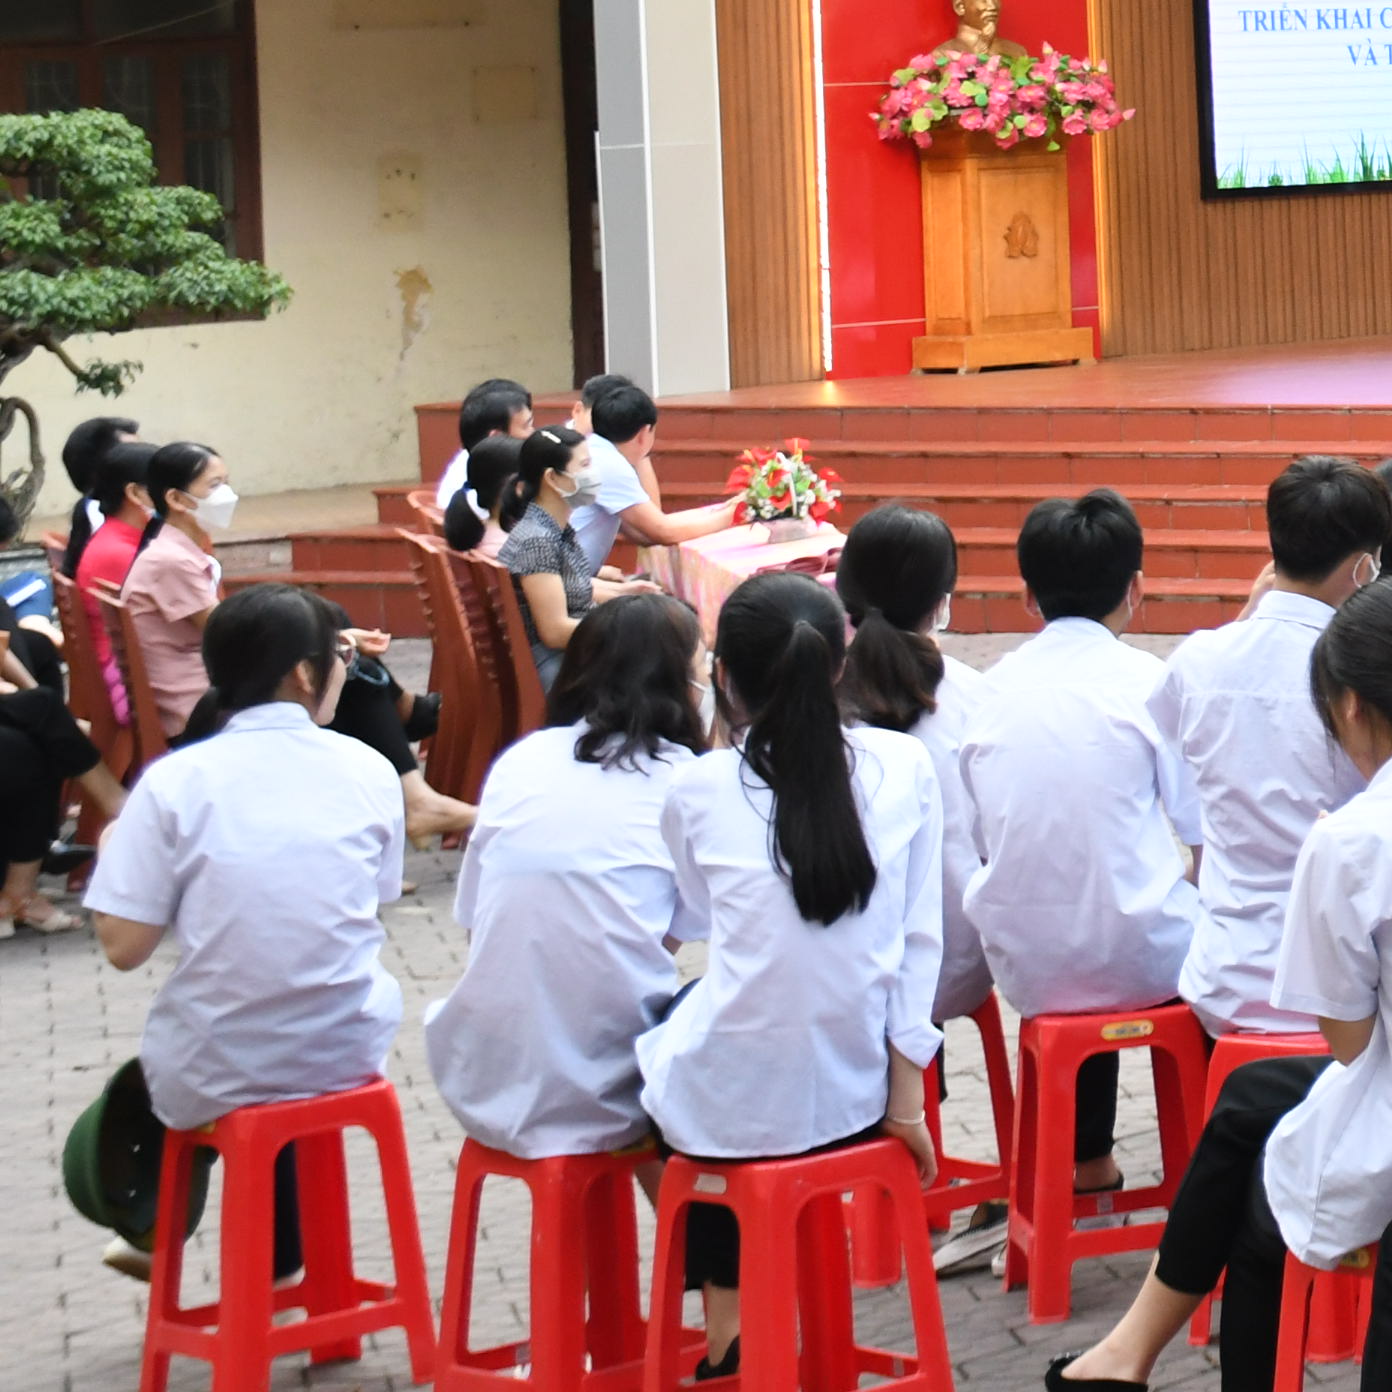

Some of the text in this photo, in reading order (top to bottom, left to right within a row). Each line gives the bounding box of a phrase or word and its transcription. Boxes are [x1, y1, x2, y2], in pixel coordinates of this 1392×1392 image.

[1238, 2, 1308, 32] TRIỂN
[1316, 8, 1372, 30] KHAI
[1347, 37, 1378, 66] VÀ
